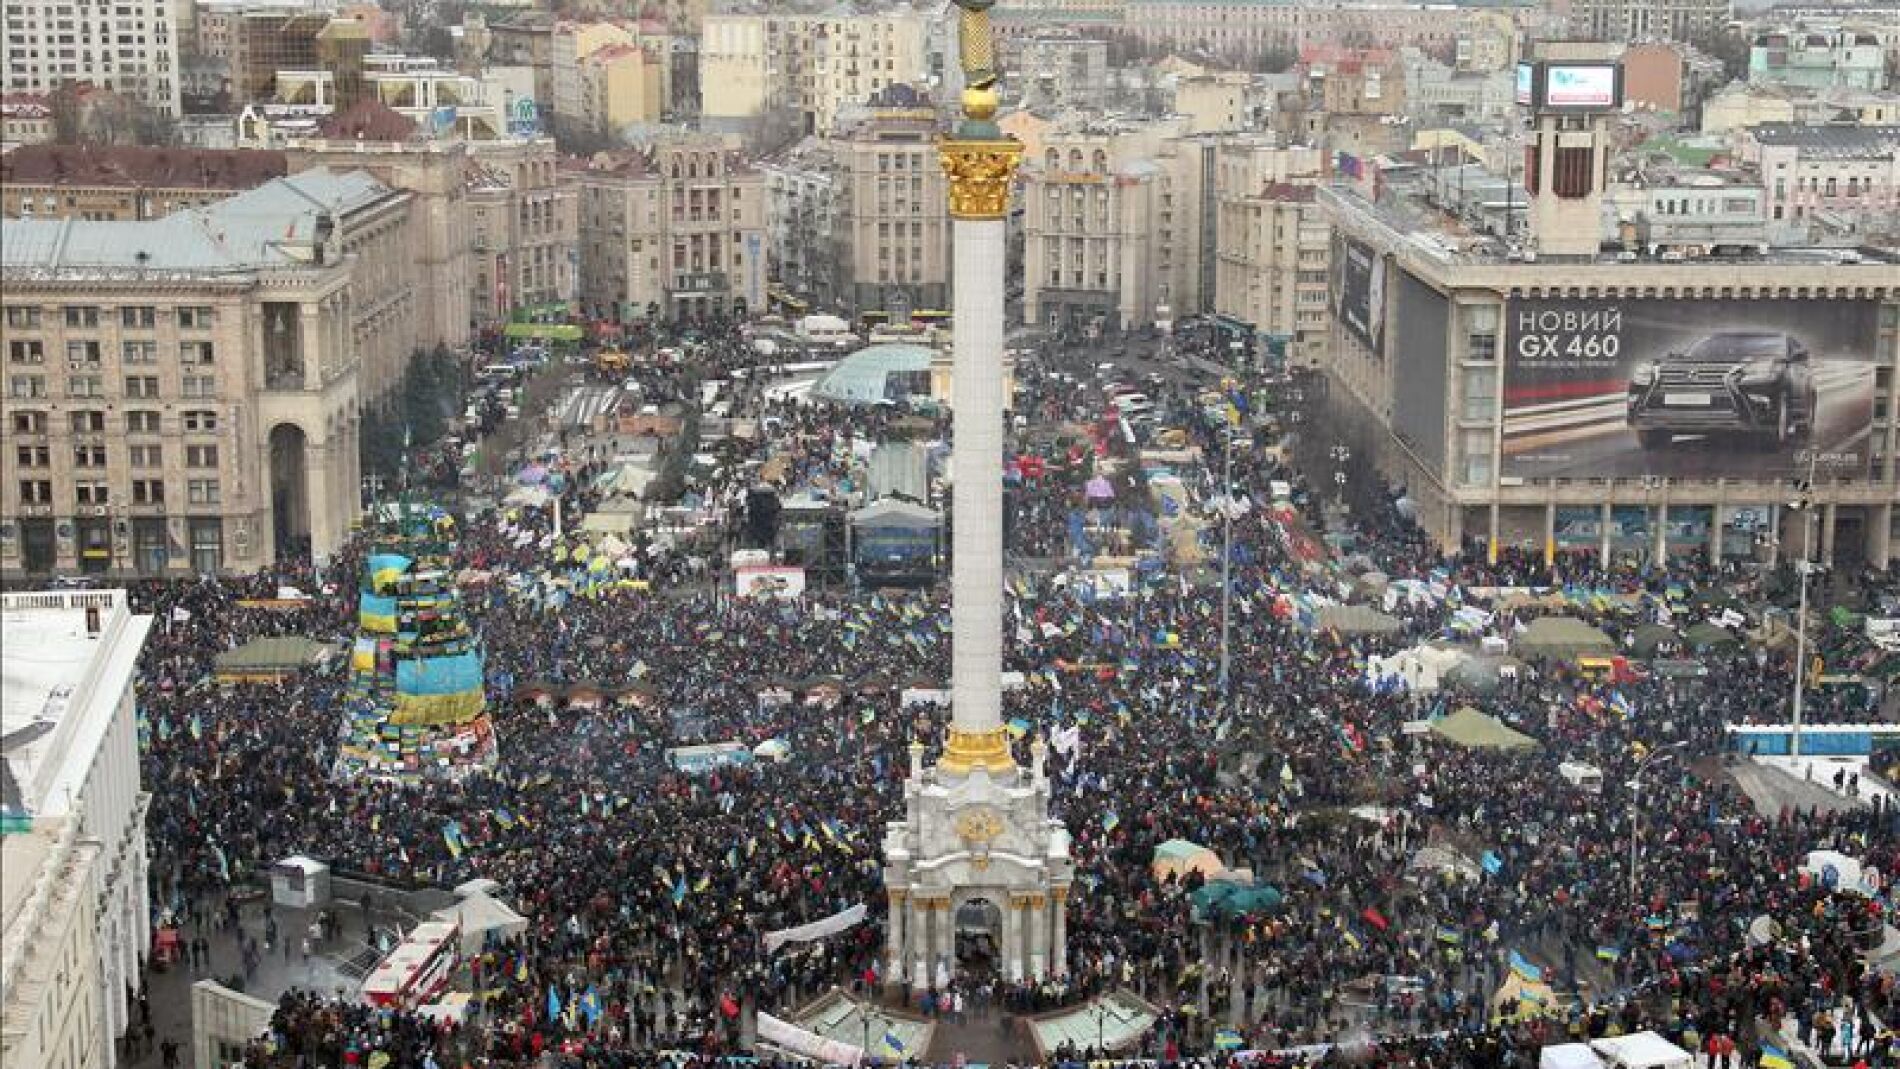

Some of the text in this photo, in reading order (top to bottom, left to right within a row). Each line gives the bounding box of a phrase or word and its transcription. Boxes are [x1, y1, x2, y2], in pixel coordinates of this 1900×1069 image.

[1520, 308, 1621, 332] НОВИЙ
[1520, 336, 1619, 357] GX 460
